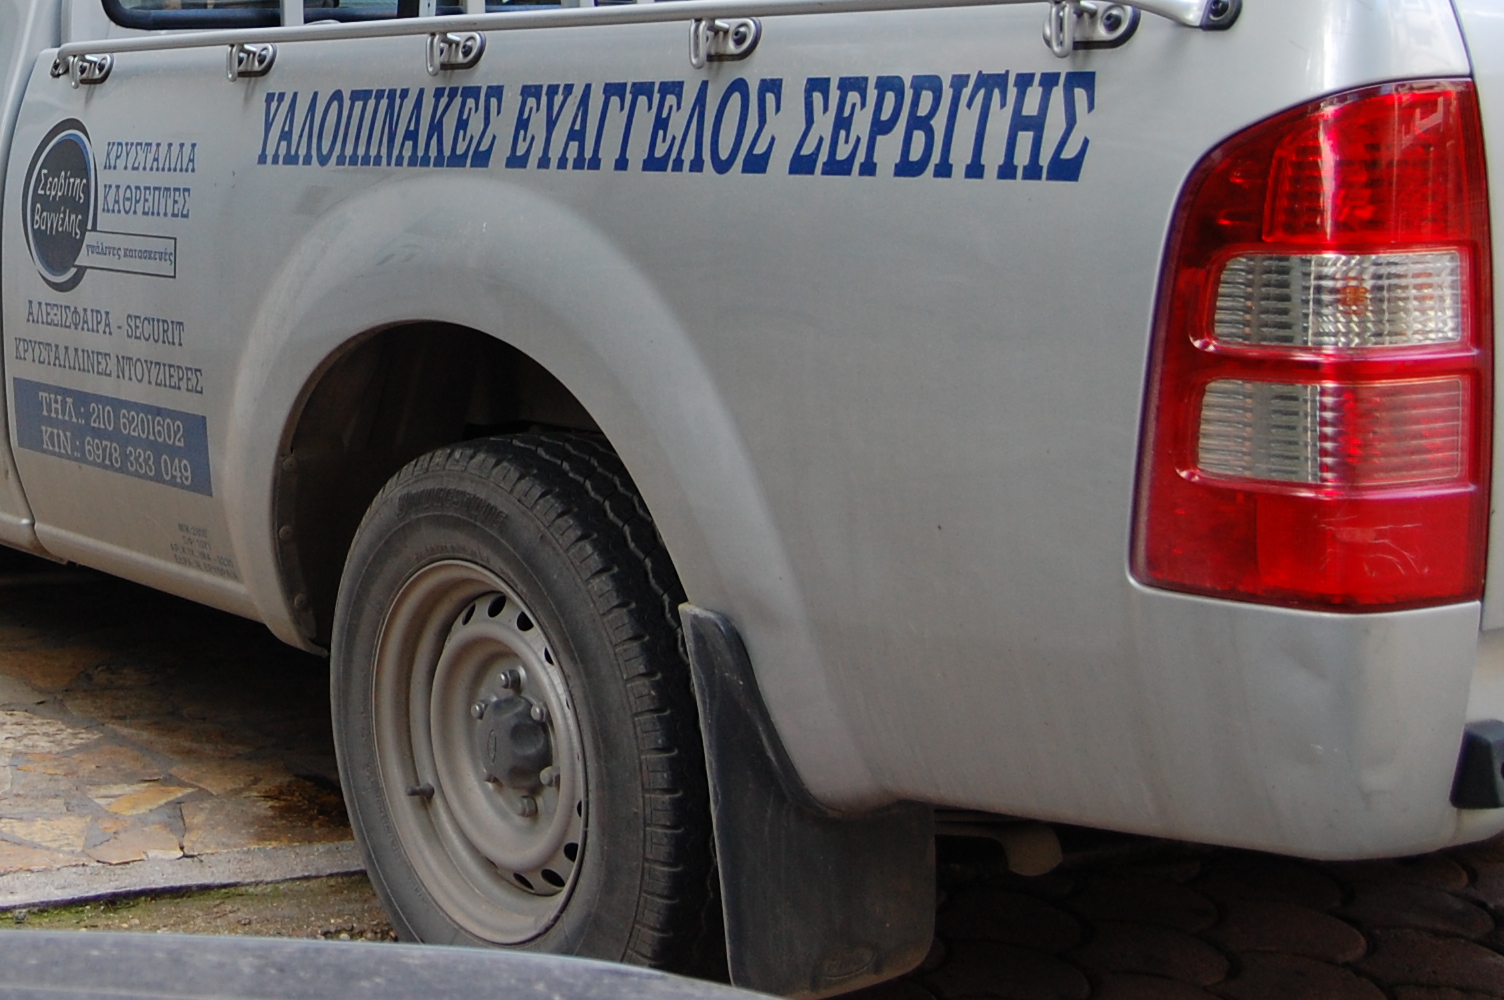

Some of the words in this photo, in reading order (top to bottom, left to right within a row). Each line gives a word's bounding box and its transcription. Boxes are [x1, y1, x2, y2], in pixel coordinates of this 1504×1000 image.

[257, 85, 502, 170] ΥΑΛΟΠΙΝΑΚΕΣ
[505, 77, 783, 176] ΕΥΑΓΓΕΛΟΣ
[788, 70, 1097, 182] ΣΕΡΒΙΤΗΣ
[103, 141, 197, 173] ΚΡΥΣΤΑΛΛΑ
[37, 168, 87, 203] Σερβίτης
[102, 184, 191, 219] ΚΑΘΡΕΠΤΕΣ
[33, 204, 83, 239] Βαγγέλης
[26, 300, 113, 336] ΑΛΕΞΙΣΦΑΙΡΑ
[126, 313, 185, 347] SECURIT
[14, 337, 112, 378] ΚΡΥΣΤΑΛΛΙΝΕΣ
[116, 355, 204, 395] ΝΤΟΥΖΙΕΡΕΣ
[90, 403, 114, 432] 210
[120, 409, 184, 447] 6201602
[85, 437, 121, 469] 6978
[127, 446, 155, 477] 333
[161, 454, 191, 485] 049
